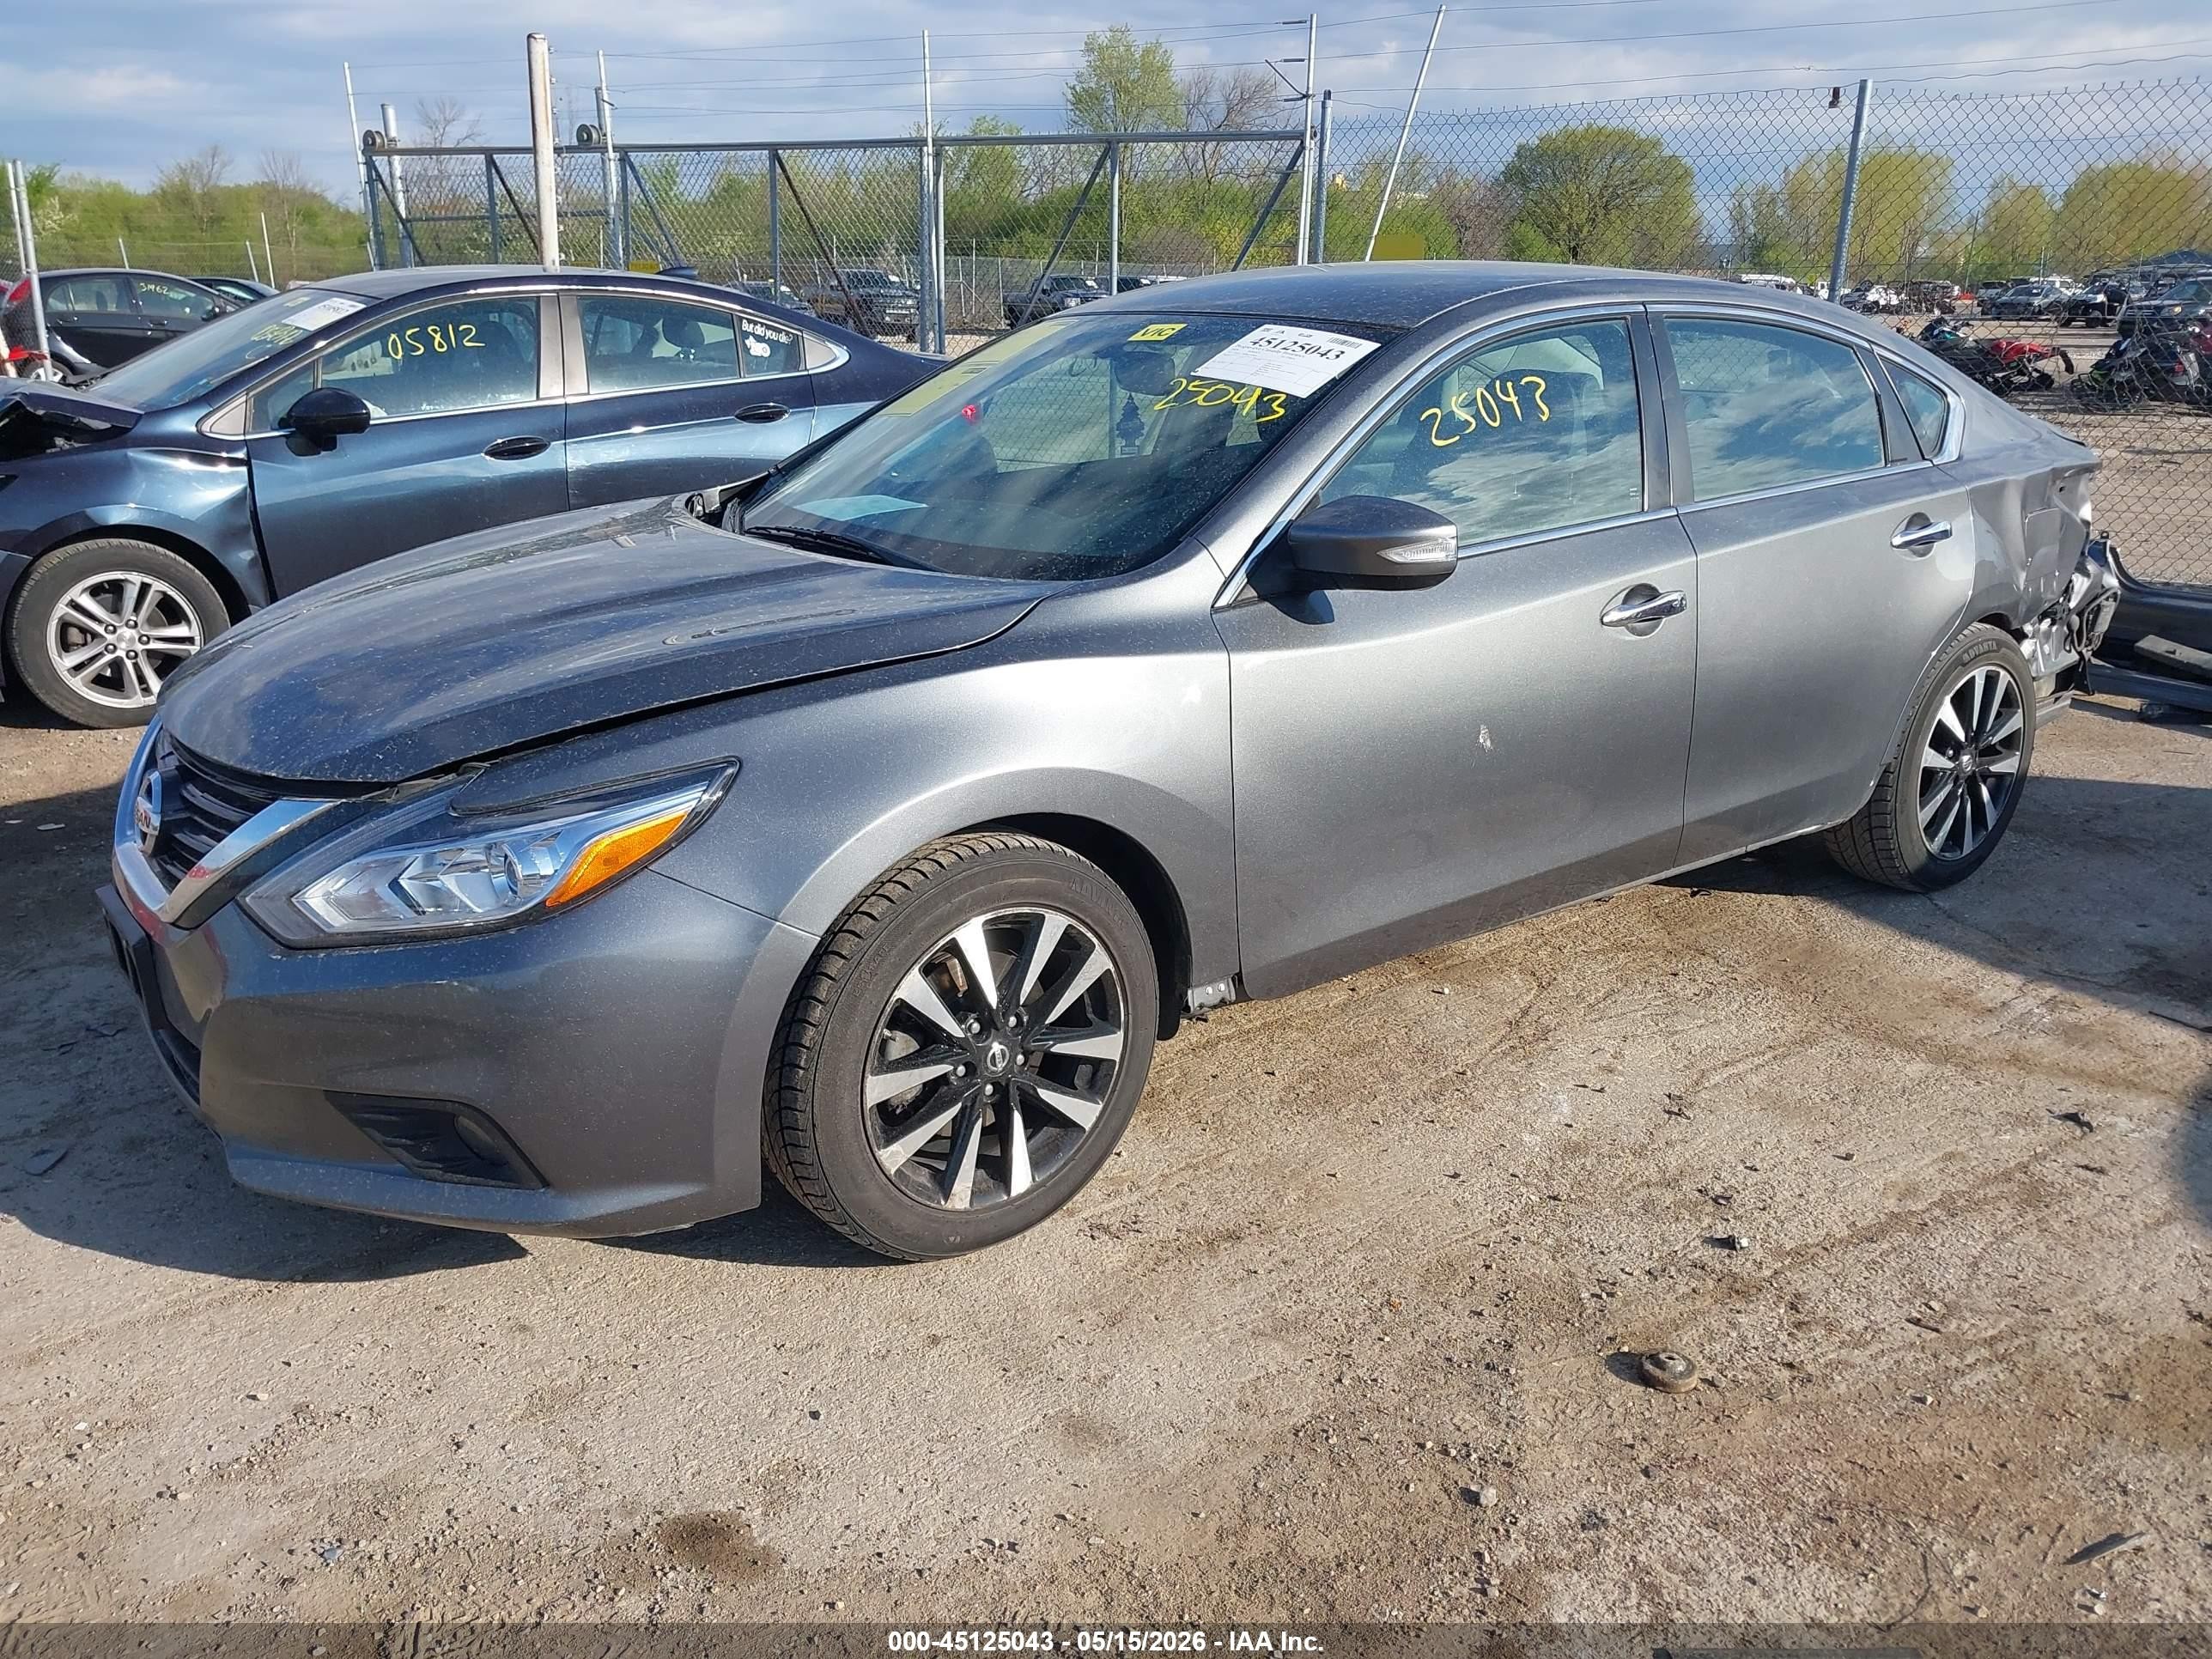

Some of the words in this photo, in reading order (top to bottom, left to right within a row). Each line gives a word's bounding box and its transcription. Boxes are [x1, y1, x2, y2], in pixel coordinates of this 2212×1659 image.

[388, 323, 486, 360] 05812
[742, 319, 754, 333] But
[754, 324, 766, 337] did
[765, 329, 779, 340] you
[1250, 336, 1346, 361] 45125043
[1153, 377, 1287, 424] 25043
[1419, 375, 1550, 447] 25043
